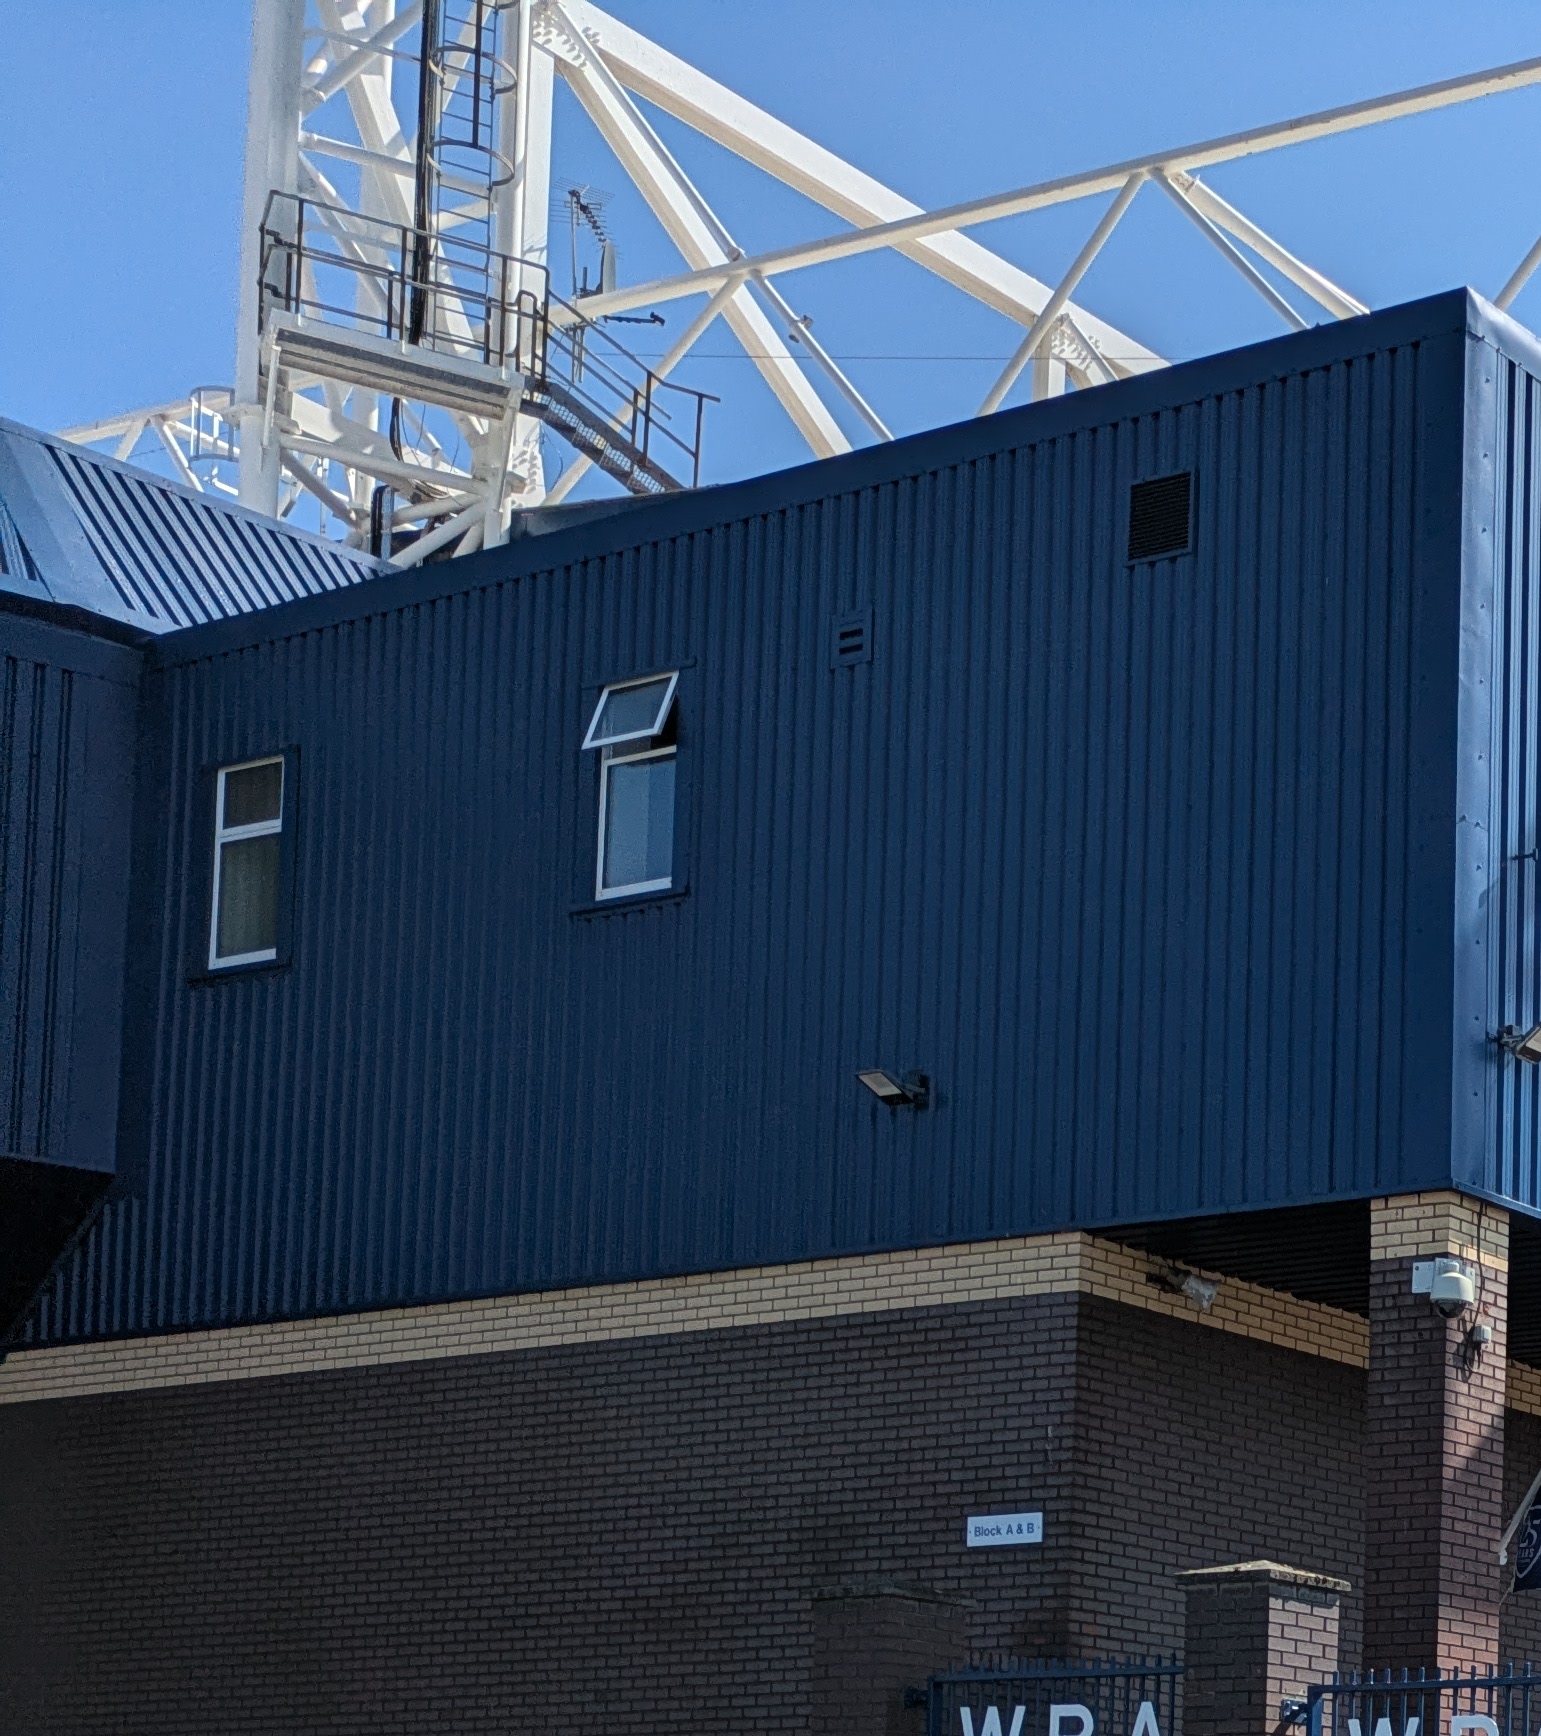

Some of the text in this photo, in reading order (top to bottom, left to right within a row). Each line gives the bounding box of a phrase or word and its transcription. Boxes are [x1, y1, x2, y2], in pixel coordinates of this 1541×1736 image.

[974, 1522, 1035, 1537] Block A & B
